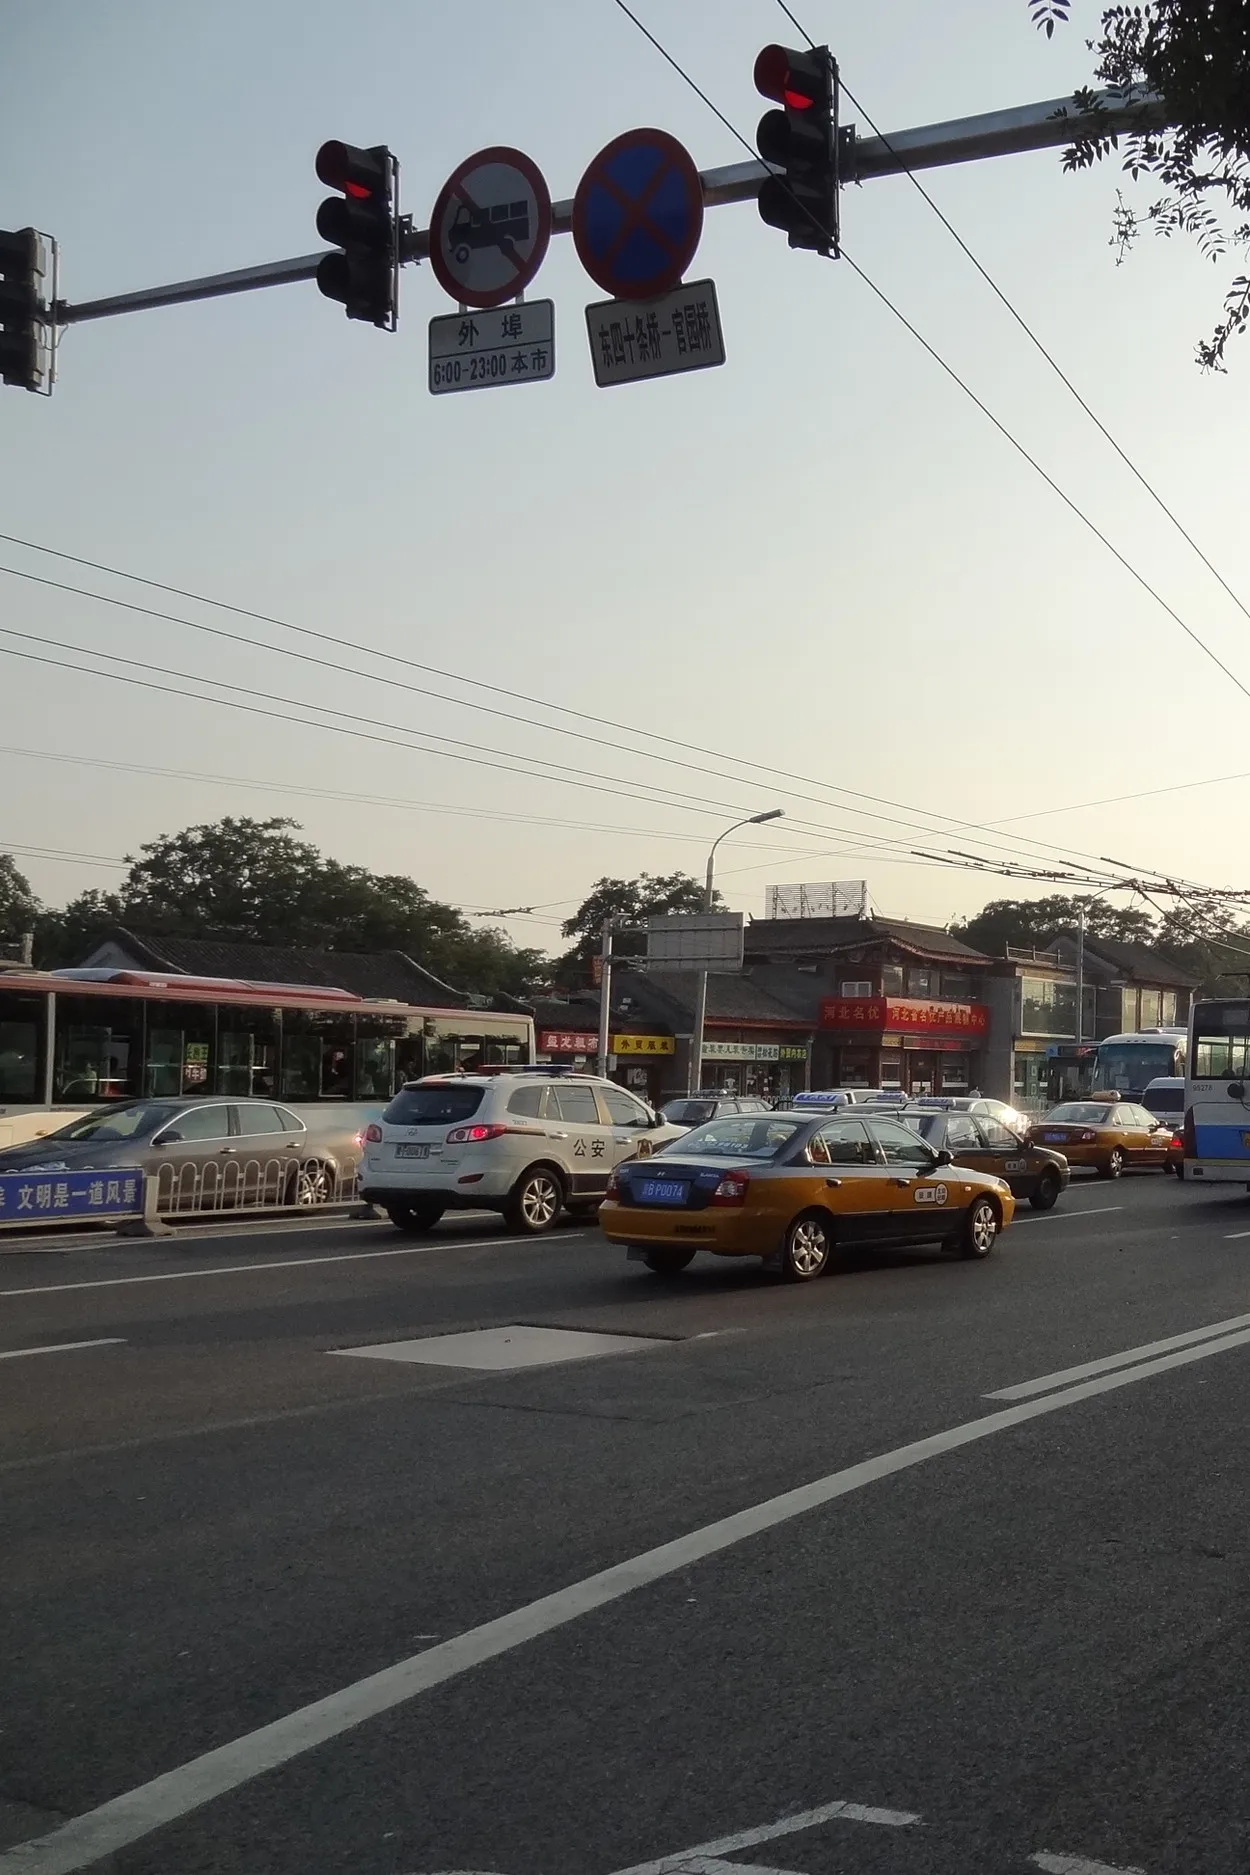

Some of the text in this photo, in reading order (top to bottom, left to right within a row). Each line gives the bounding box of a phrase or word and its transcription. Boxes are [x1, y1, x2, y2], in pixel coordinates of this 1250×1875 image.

[433, 348, 549, 386] 6:00-23:00 本市
[823, 1004, 880, 1021] 河北名优
[573, 1138, 605, 1158] 公安
[17, 1179, 137, 1210] 文明是一道风景
